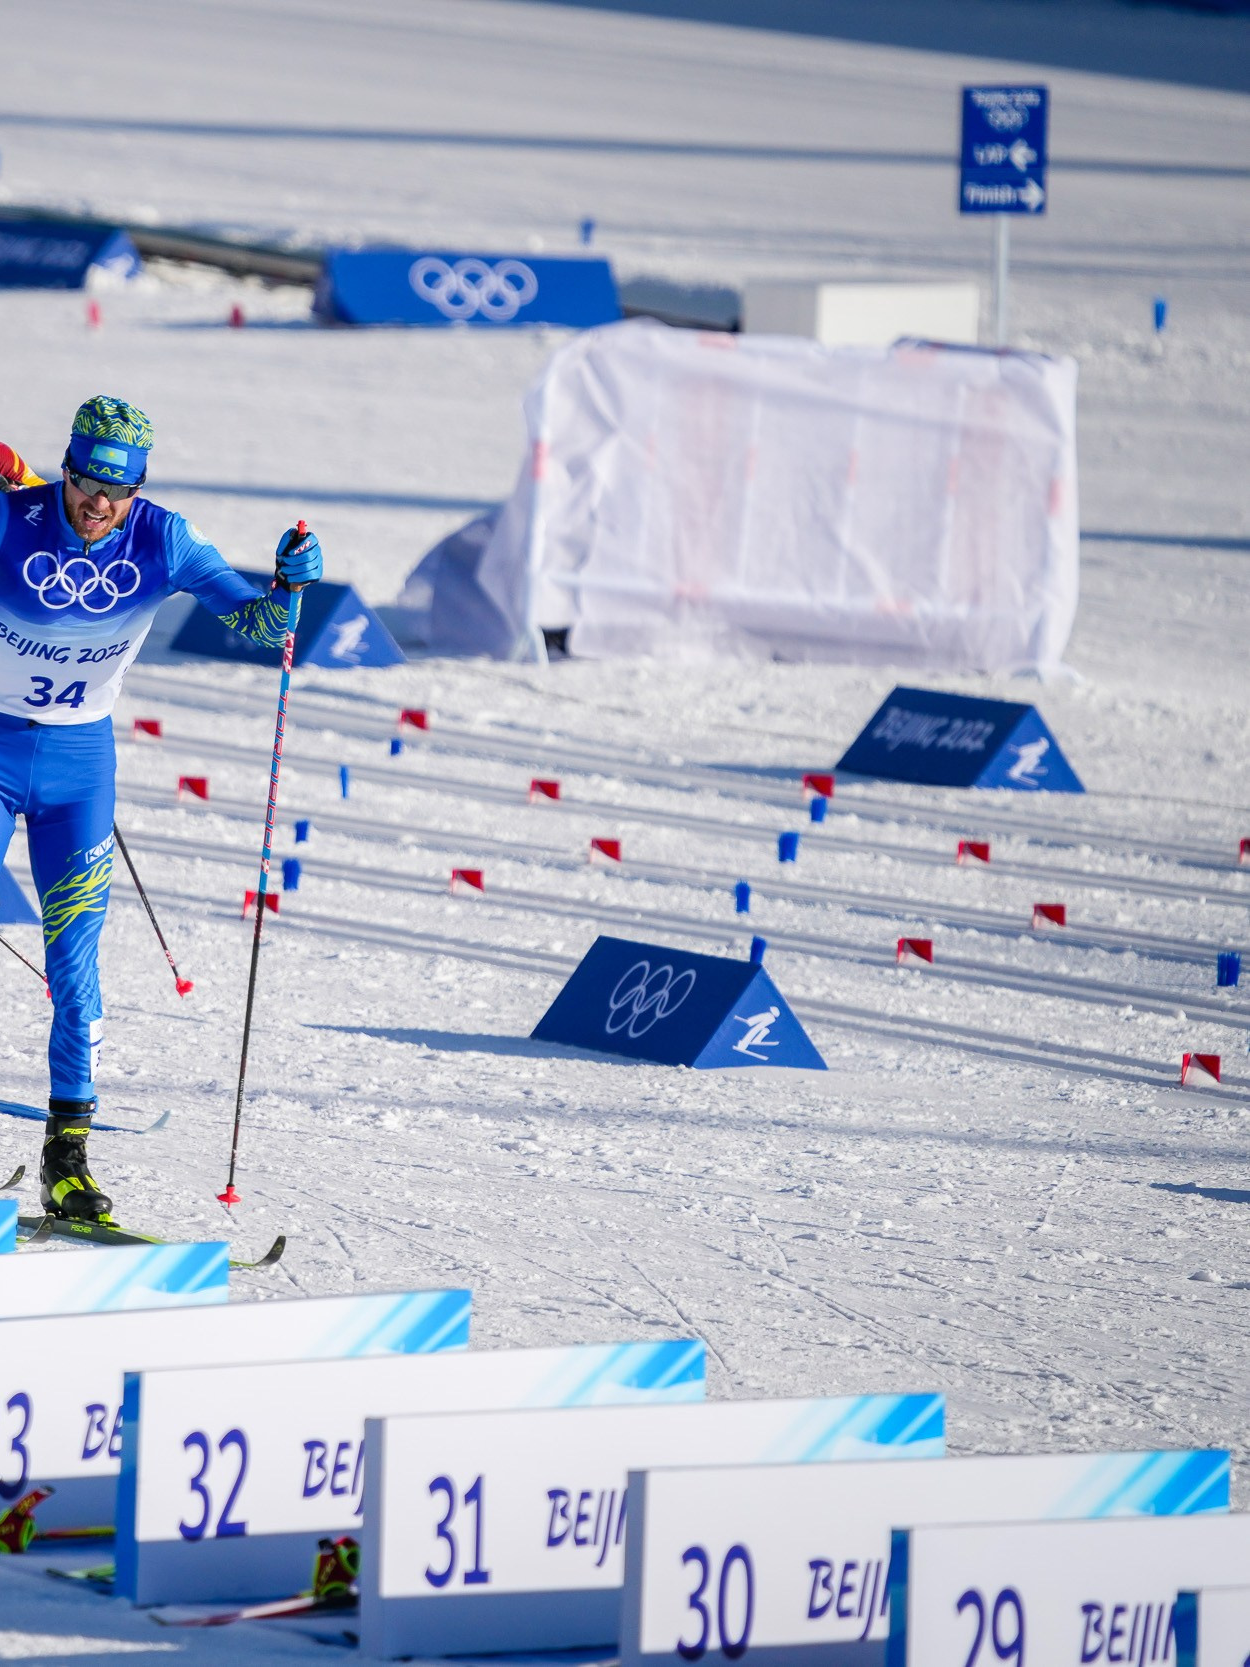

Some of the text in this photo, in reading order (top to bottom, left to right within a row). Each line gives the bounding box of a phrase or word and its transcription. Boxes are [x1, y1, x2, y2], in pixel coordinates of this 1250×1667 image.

[87, 462, 126, 480] KAZ
[76, 639, 130, 664] 2022
[22, 675, 88, 709] 34
[263, 689, 290, 850] TORNADO
[70, 1224, 93, 1234] FISCHER
[177, 1428, 249, 1541] 32
[424, 1474, 491, 1588] 31
[676, 1543, 753, 1662] 30
[955, 1587, 1025, 1667] 29
